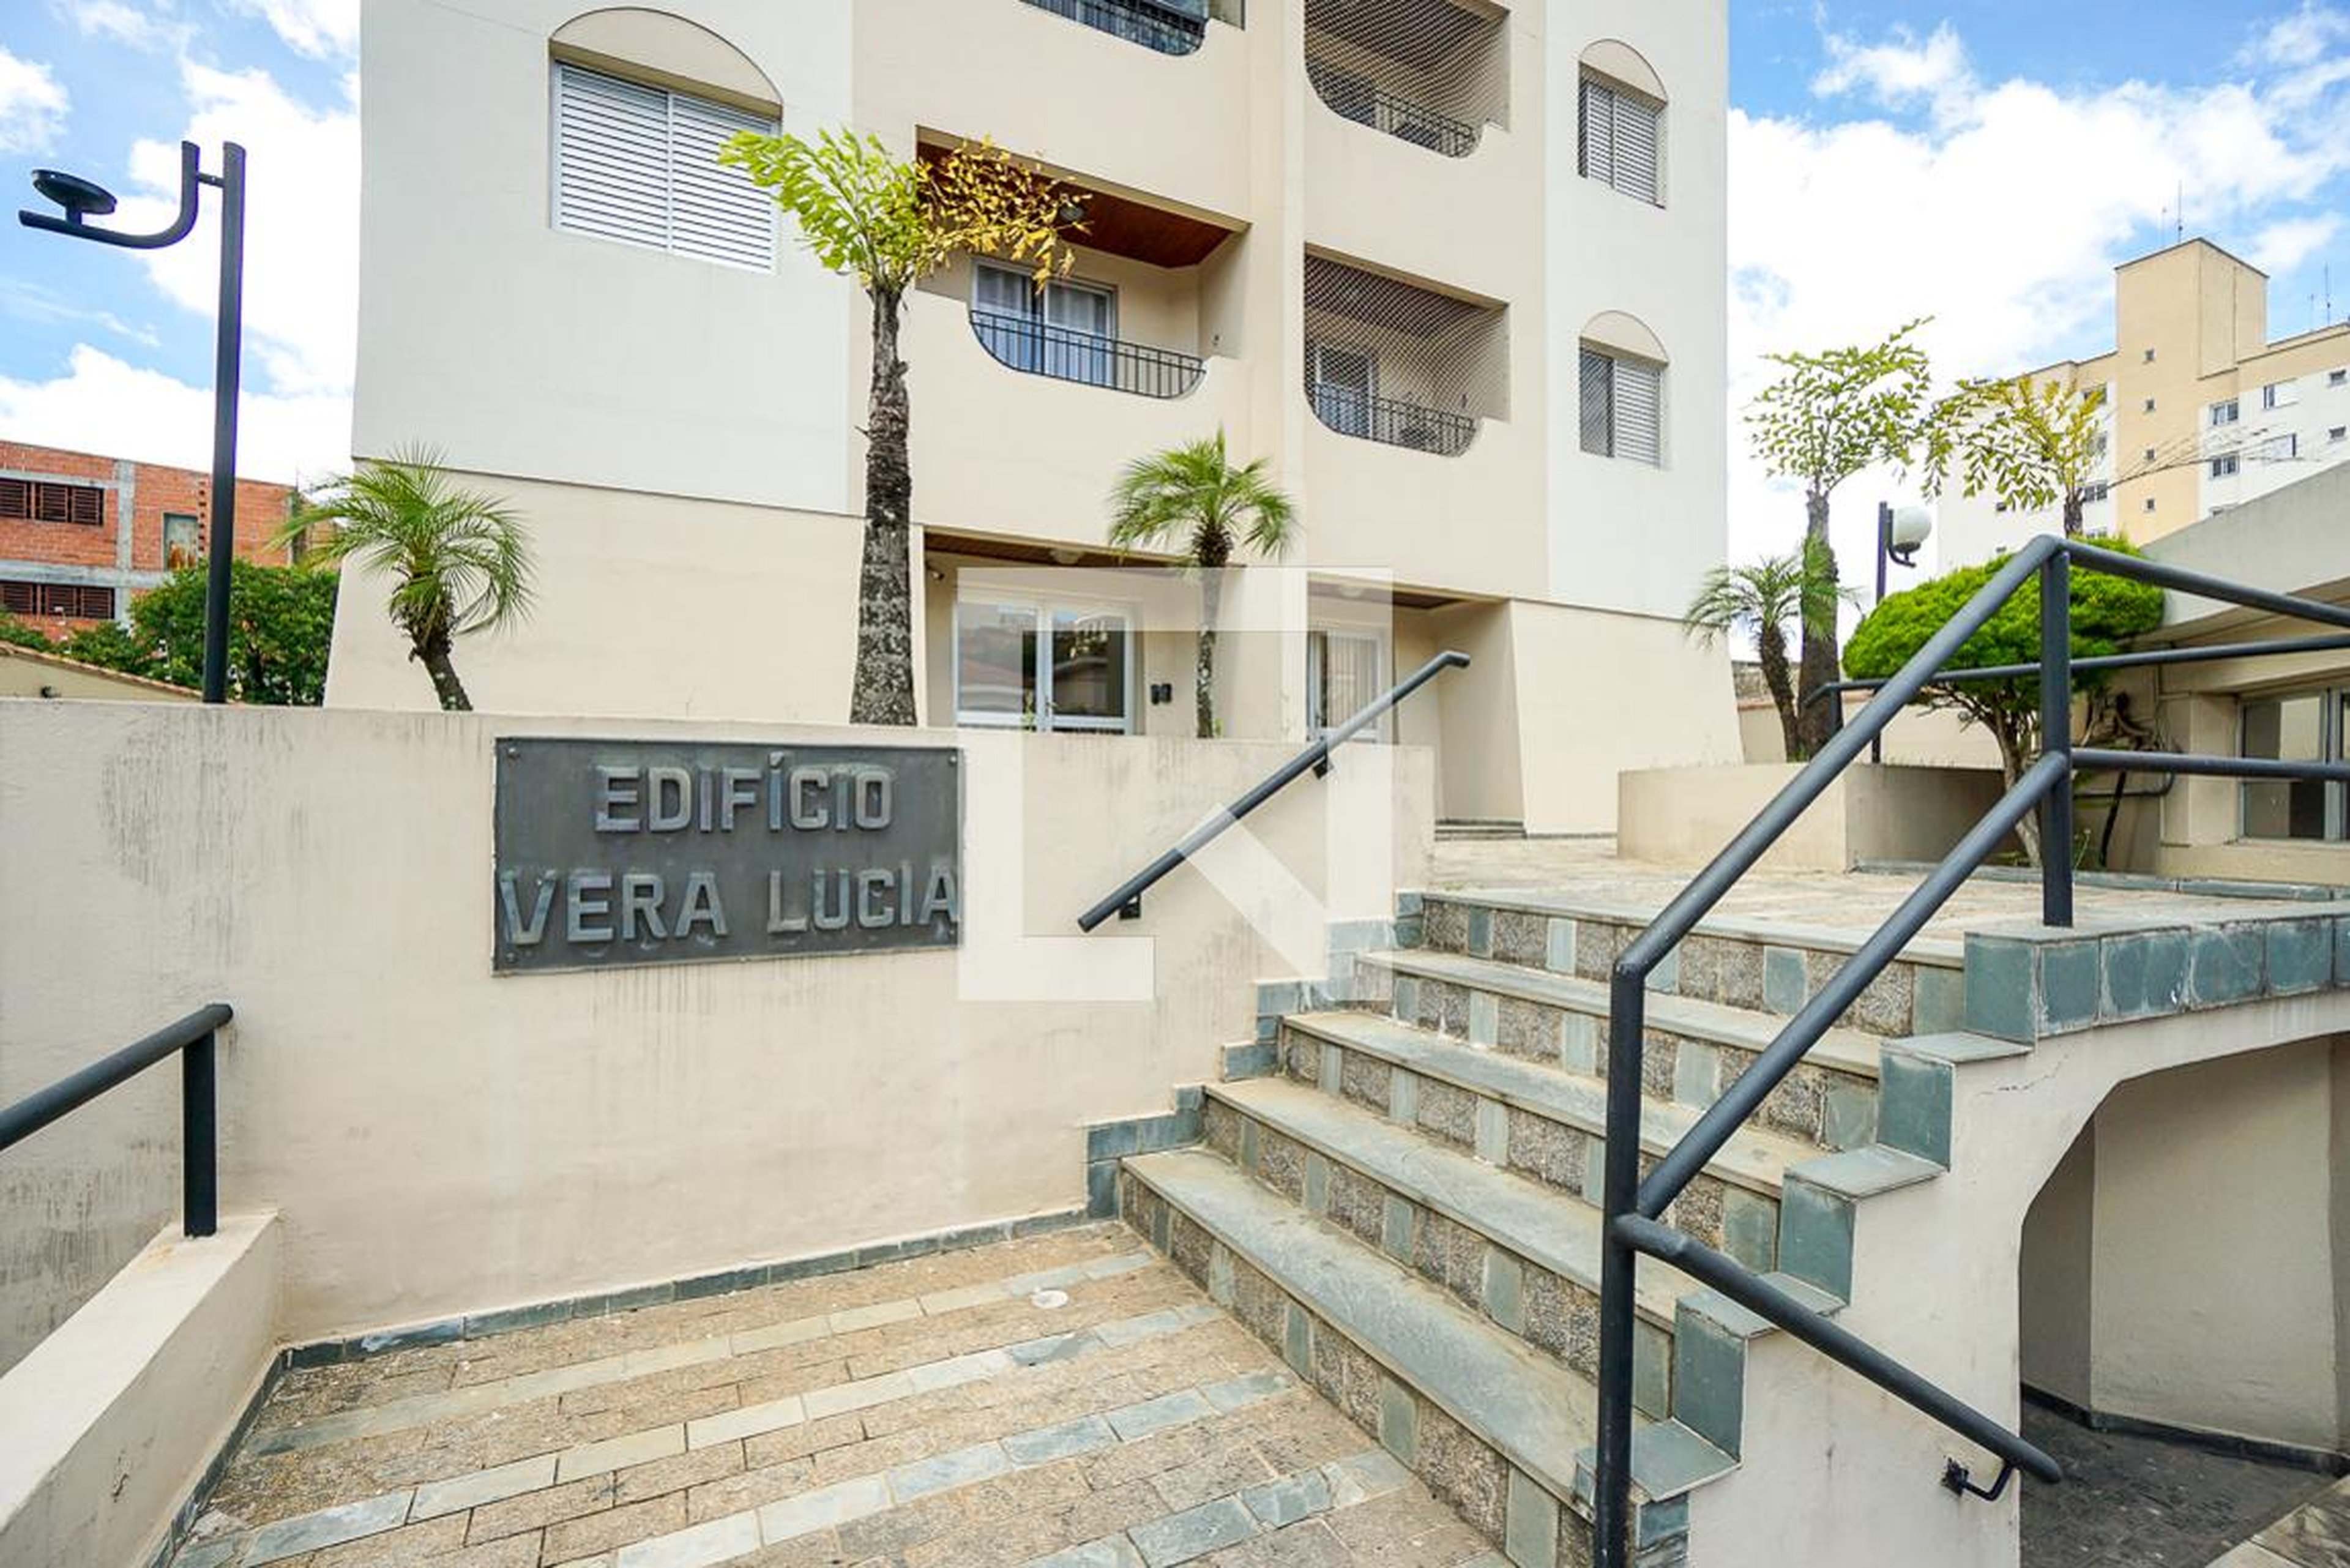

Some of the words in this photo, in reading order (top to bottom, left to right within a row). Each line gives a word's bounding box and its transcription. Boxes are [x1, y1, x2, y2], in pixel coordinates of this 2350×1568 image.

[594, 750, 892, 832] EDIFÍCIO
[501, 869, 728, 944] VERA
[767, 861, 958, 933] LUCIA
